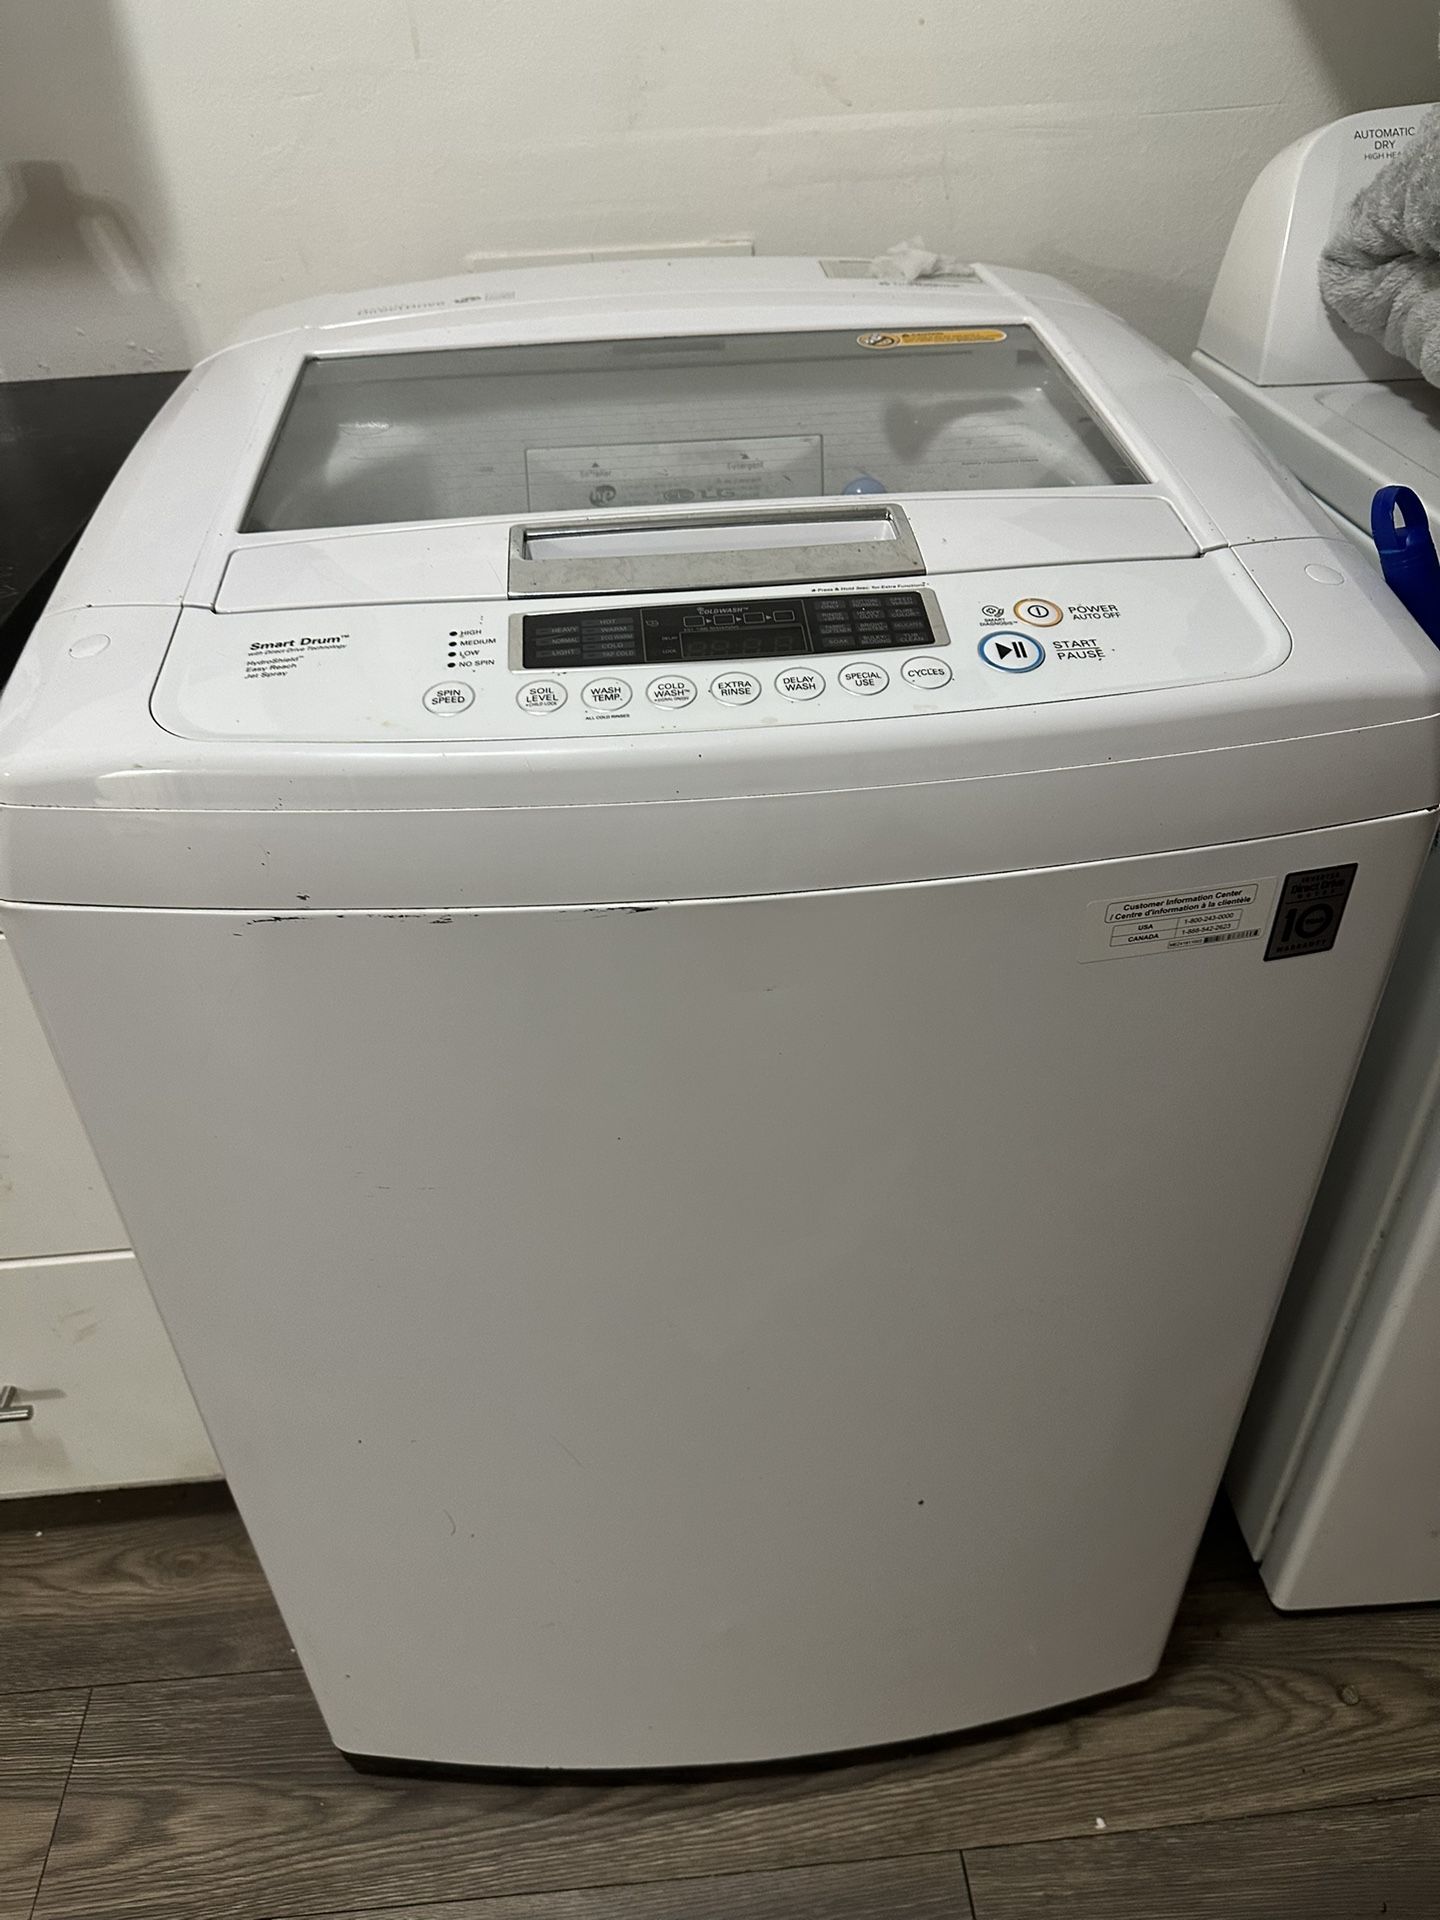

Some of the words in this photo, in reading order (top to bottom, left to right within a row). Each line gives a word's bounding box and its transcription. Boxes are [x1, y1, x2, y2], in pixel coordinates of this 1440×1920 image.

[1354, 126, 1416, 140] AUTOMATIC
[1374, 140, 1396, 150] DRY
[1364, 152, 1385, 160] HIGH
[1068, 604, 1118, 614] POWER
[1072, 612, 1100, 620] AUTO
[1102, 611, 1121, 619] OFF
[249, 640, 296, 651] Smart
[460, 638, 497, 646] MEDIUM
[1052, 639, 1098, 648] START
[459, 649, 480, 657] LOW
[551, 648, 575, 656] LIGHT
[1057, 649, 1106, 660] PAUSE
[845, 672, 882, 680] SPECIAL
[907, 668, 945, 677] CYCLES
[783, 676, 814, 684] DELAY
[855, 679, 875, 687] USE
[657, 682, 685, 690] COLD
[718, 681, 752, 689] EXTRA
[785, 683, 816, 692] WASH
[721, 688, 752, 696] RINSE
[432, 696, 465, 705] SPEED
[526, 694, 559, 702] LEVEL
[593, 694, 623, 702] TEMP.
[1123, 900, 1165, 912] Customer
[1166, 893, 1213, 906] Information
[1215, 889, 1243, 899] Center
[1115, 911, 1143, 920] Centre
[1144, 903, 1200, 916] d'information
[1208, 899, 1216, 908] la
[1217, 895, 1252, 907] clientèle
[1127, 933, 1160, 943] CANADA
